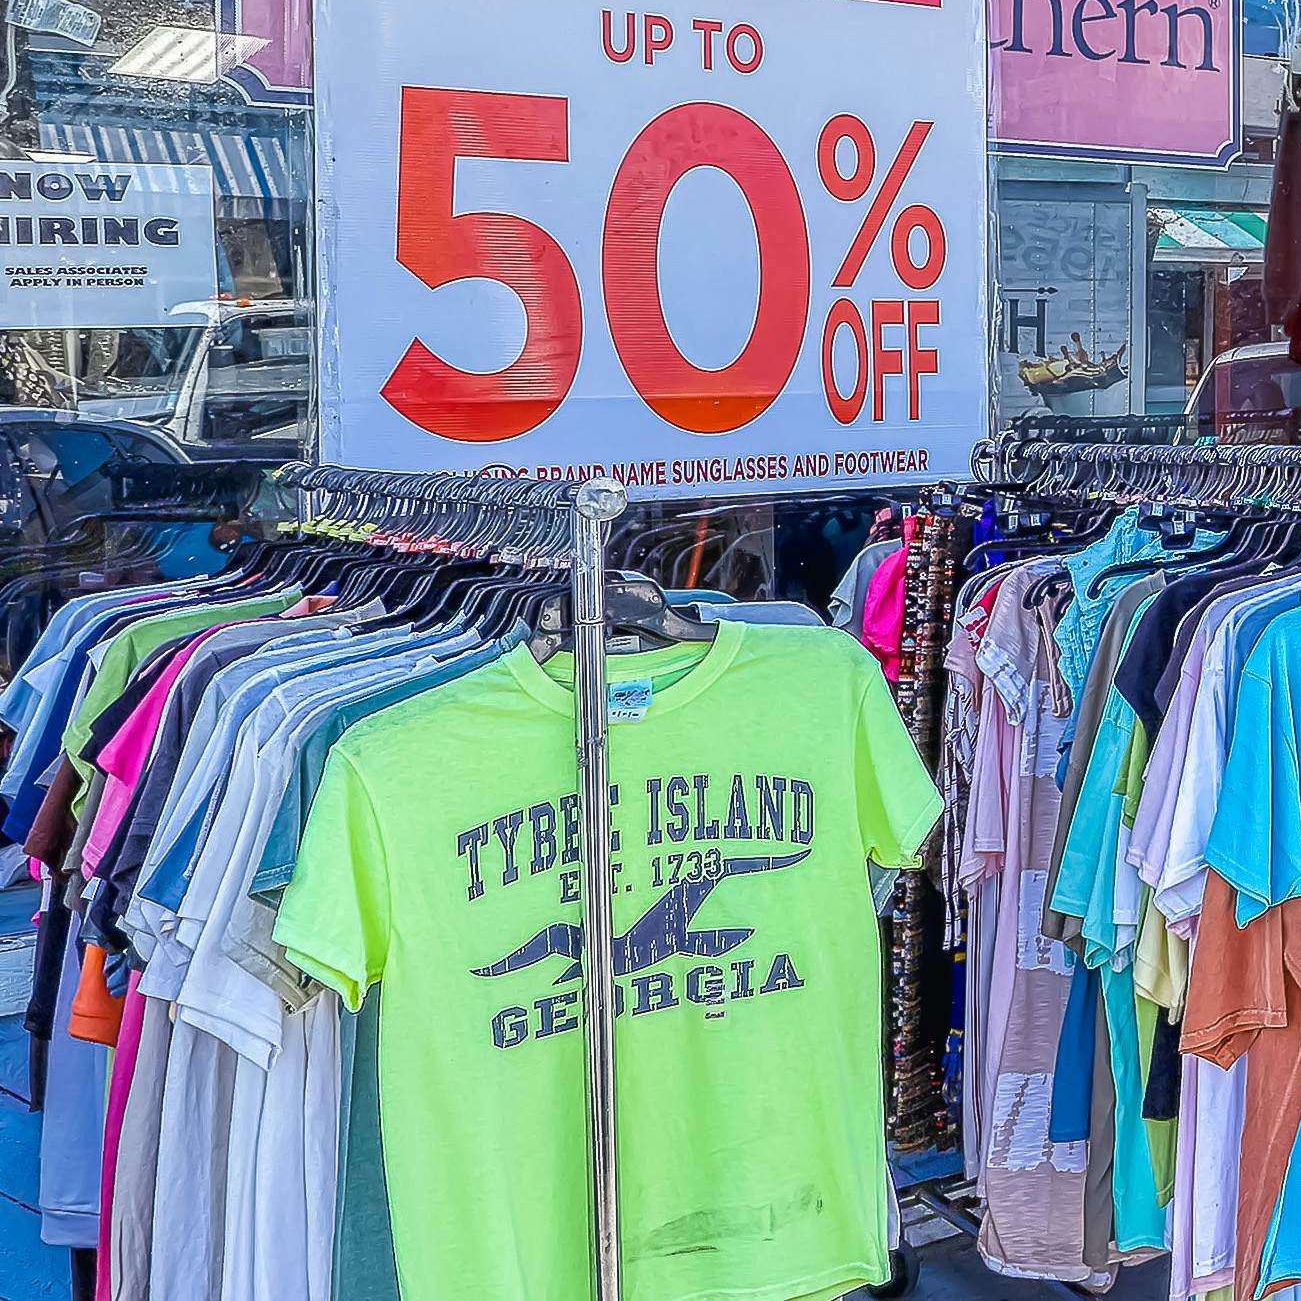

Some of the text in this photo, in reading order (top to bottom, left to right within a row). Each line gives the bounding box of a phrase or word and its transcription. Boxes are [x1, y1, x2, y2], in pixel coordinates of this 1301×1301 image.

[602, 10, 764, 74] UP TO
[0, 172, 132, 201] NOW
[5, 266, 148, 275] SALES ASSOCIATES
[10, 278, 144, 287] APPLY IN PERSON
[379, 85, 947, 443] 50%
[822, 299, 940, 426] OFF
[612, 461, 666, 486] NAME
[671, 456, 788, 484] SUNGLASSES
[792, 453, 829, 478] AND
[834, 450, 929, 476] FOOTWEAR
[646, 774, 816, 846] ISLAND
[559, 847, 723, 904] ET. 1733
